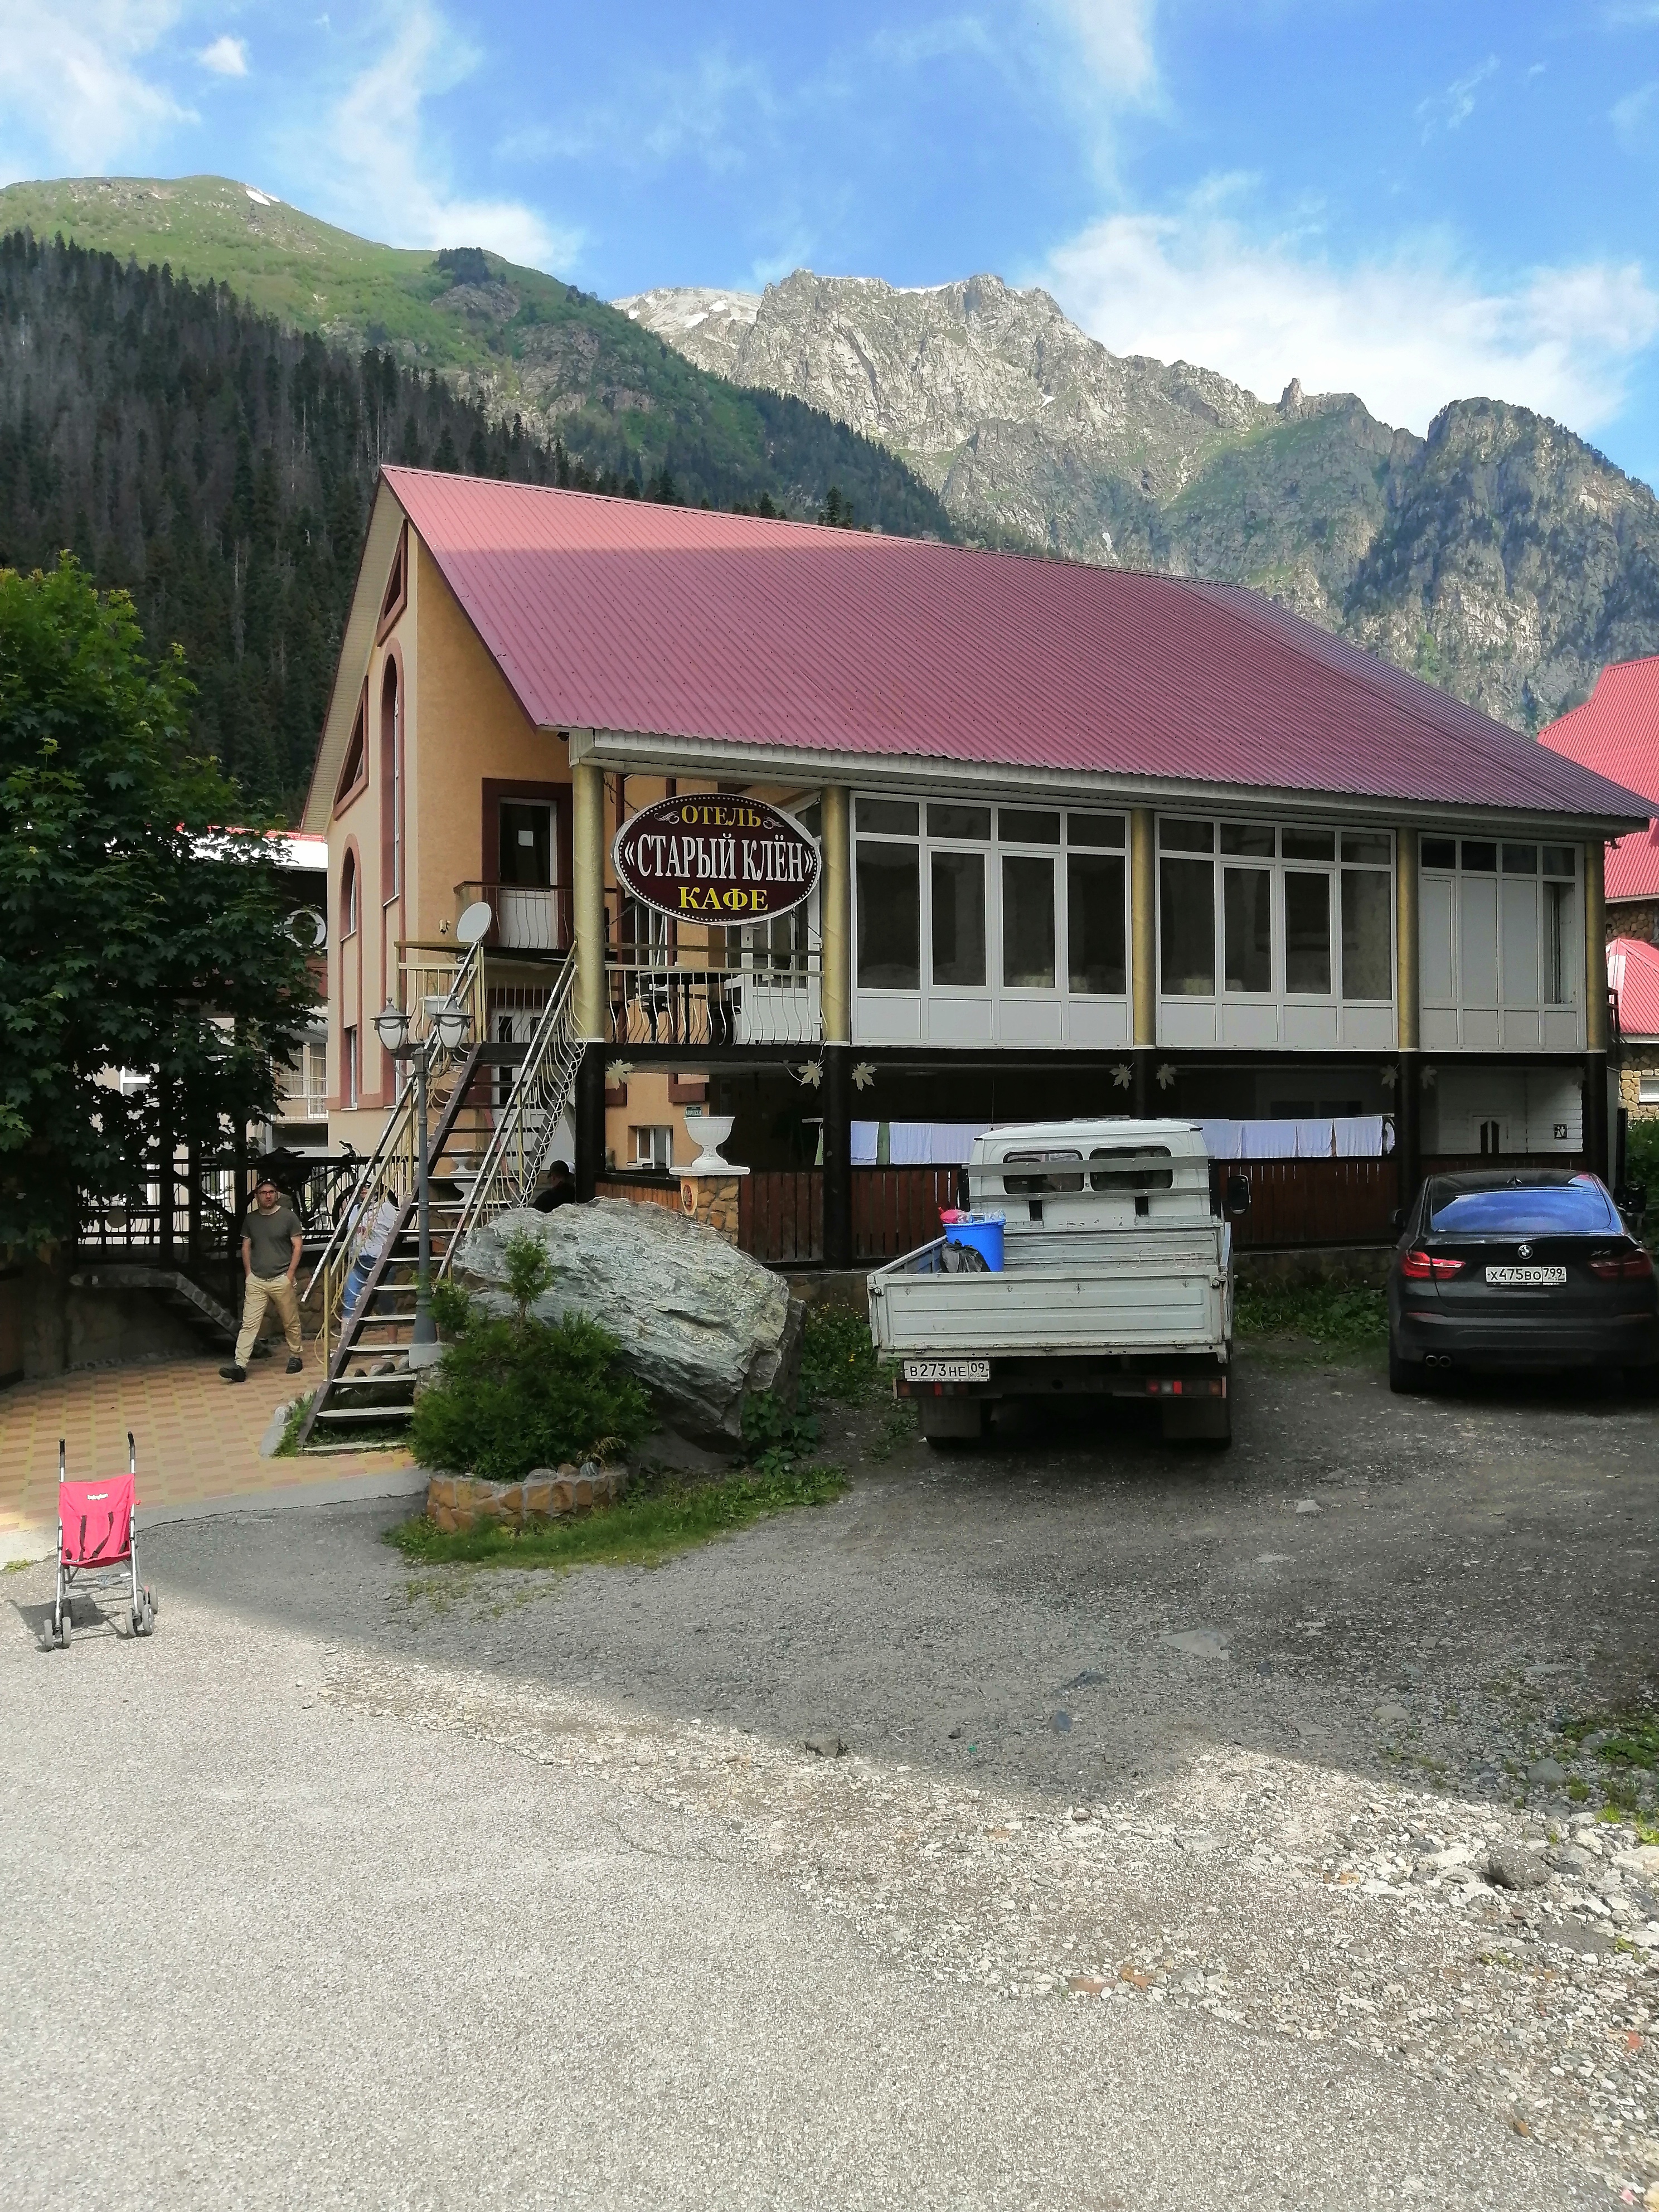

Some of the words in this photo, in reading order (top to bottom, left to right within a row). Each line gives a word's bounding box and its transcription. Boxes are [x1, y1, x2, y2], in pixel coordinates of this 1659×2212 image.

[681, 805, 761, 827] ОТЕЛЬ
[677, 886, 769, 911] КАФЕ
[971, 1362, 985, 1373] 09
